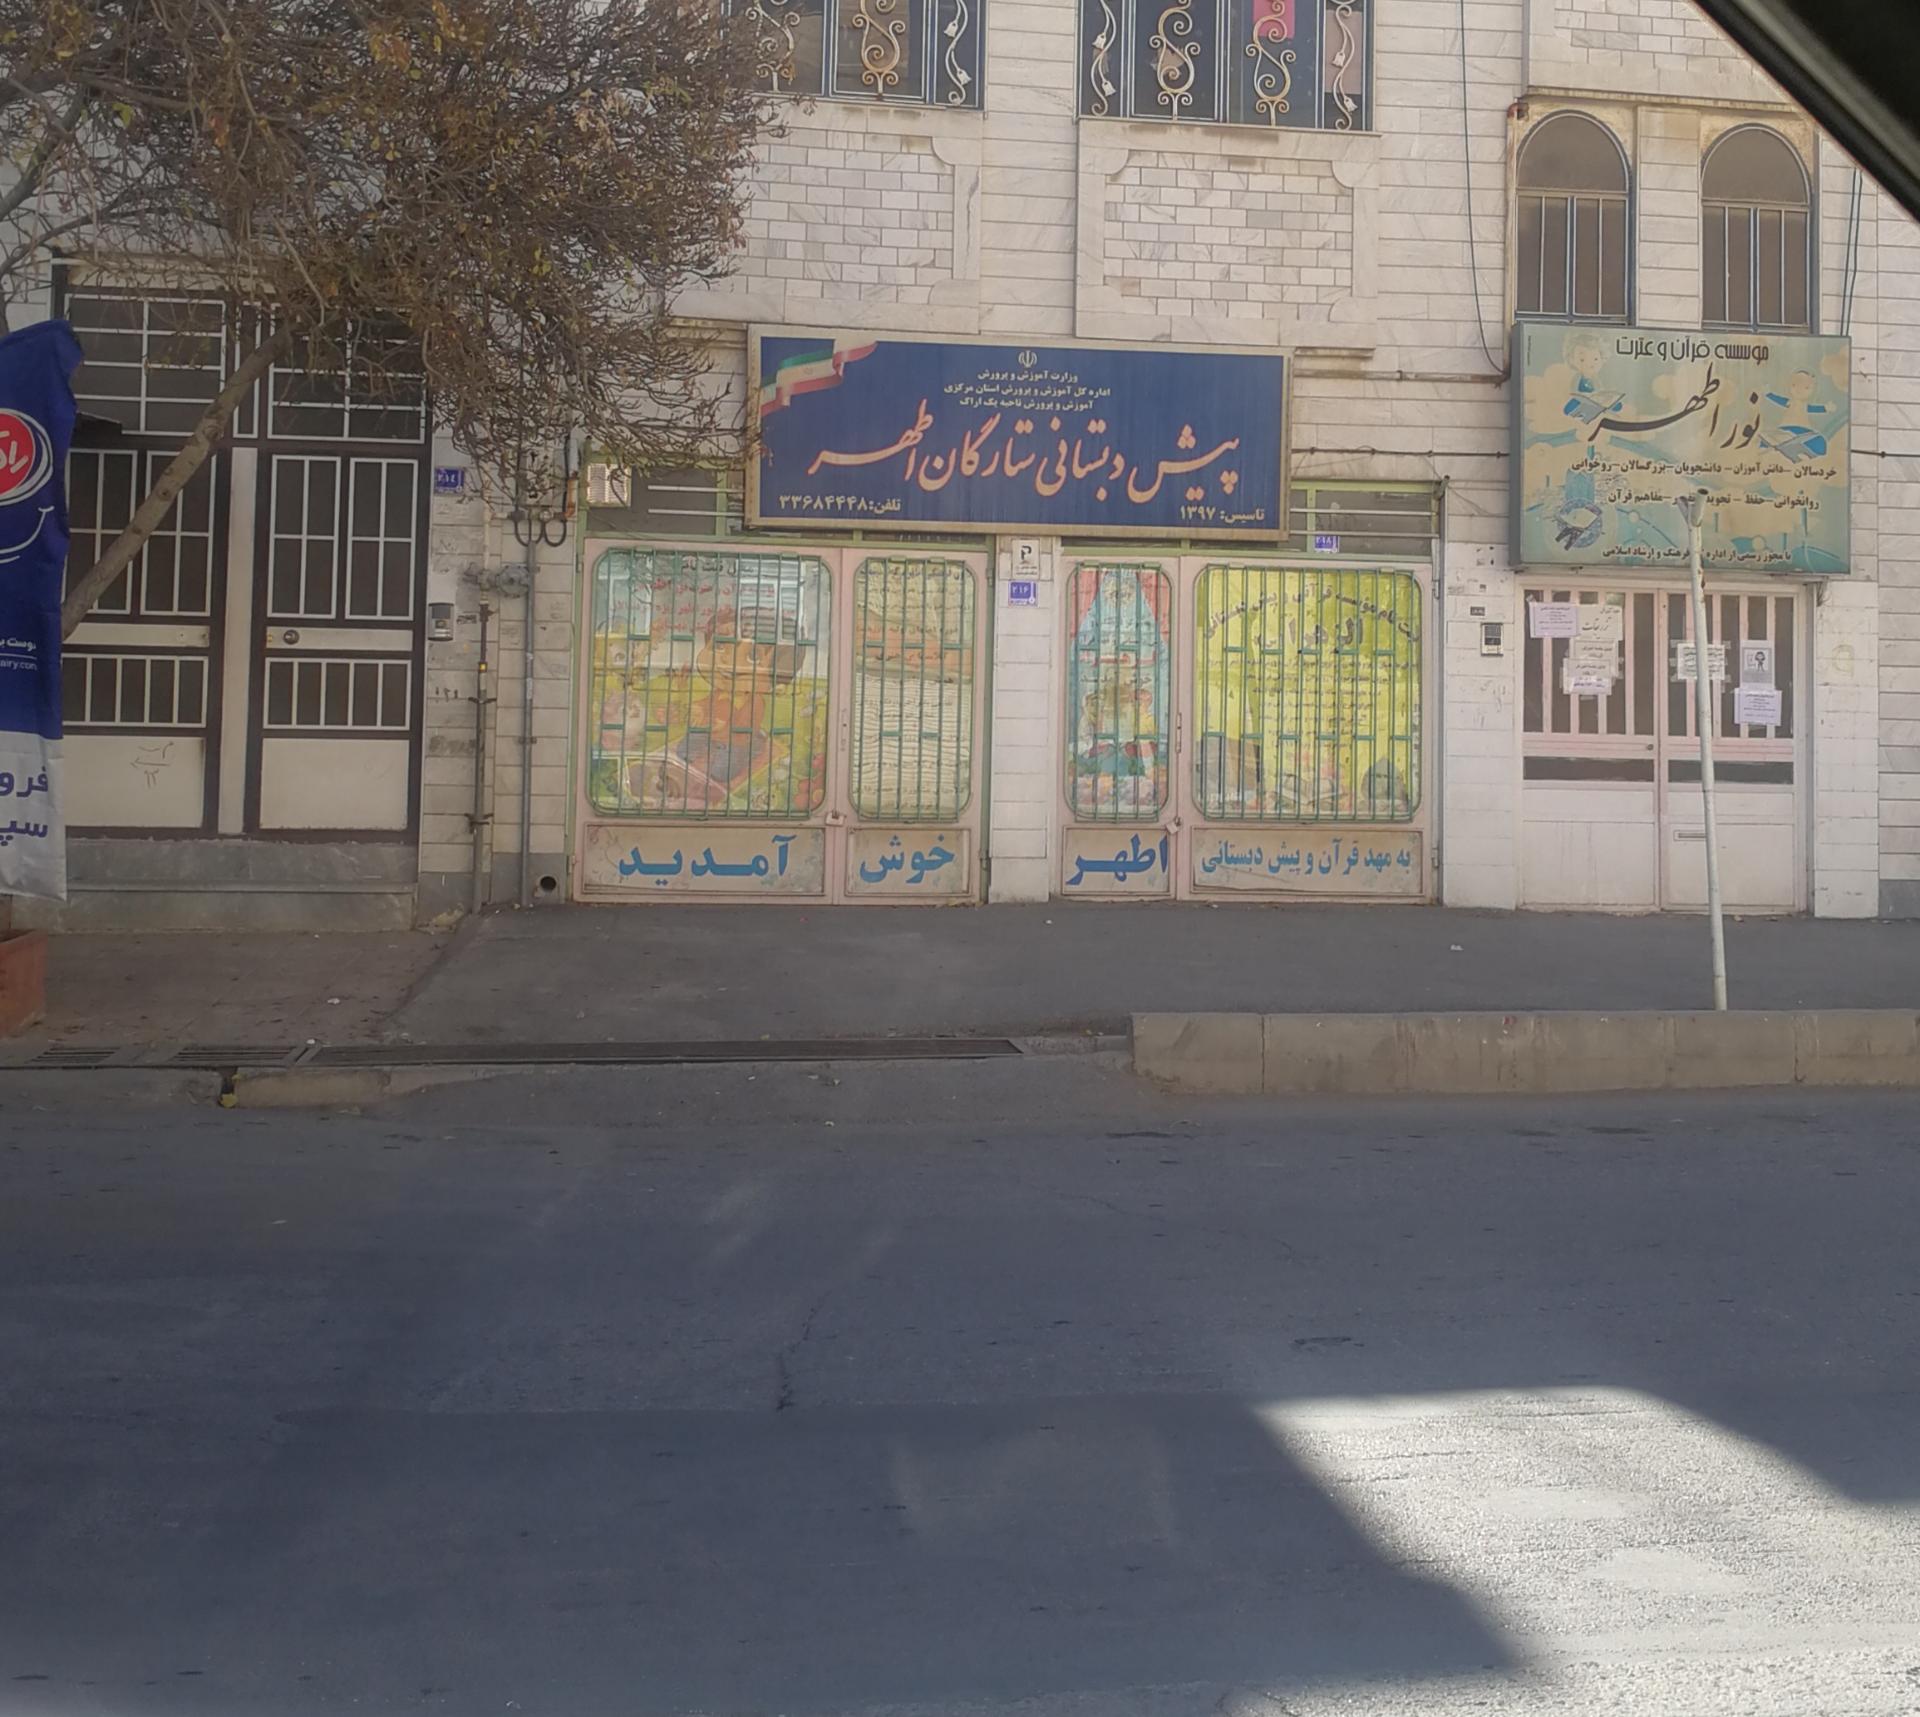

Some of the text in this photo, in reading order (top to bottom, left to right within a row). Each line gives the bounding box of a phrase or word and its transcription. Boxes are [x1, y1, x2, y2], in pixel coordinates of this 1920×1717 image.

[1616, 336, 1769, 366] موسسه قرآن و عترت
[977, 368, 1009, 381] پرورش
[1016, 369, 1049, 381] آموزش
[1050, 370, 1079, 384] وزارت
[943, 382, 974, 394] مرکزی
[975, 383, 1000, 394] استان
[1001, 383, 1031, 396] پرورش
[1039, 384, 1071, 397] آموزش
[1073, 386, 1087, 398] کل
[1088, 387, 1111, 399] اداره
[959, 396, 982, 408] اراک
[1000, 399, 1022, 409] ناحیه
[1023, 398, 1054, 410] پرورش
[1062, 400, 1094, 411] آموزش
[1587, 361, 1761, 449] نور اطهر
[807, 398, 1240, 504] پیش دبستانی ستارگان اطهر
[1793, 464, 1838, 479] خردسالان
[1608, 488, 1633, 504] قرآن
[1180, 505, 1216, 521] ۱۳۹۷
[618, 833, 797, 887] آمدید
[858, 834, 955, 885] خوش
[1065, 833, 1170, 887] اطهر
[1202, 837, 1412, 877] به مهد قرآن و پیش دبستانی
